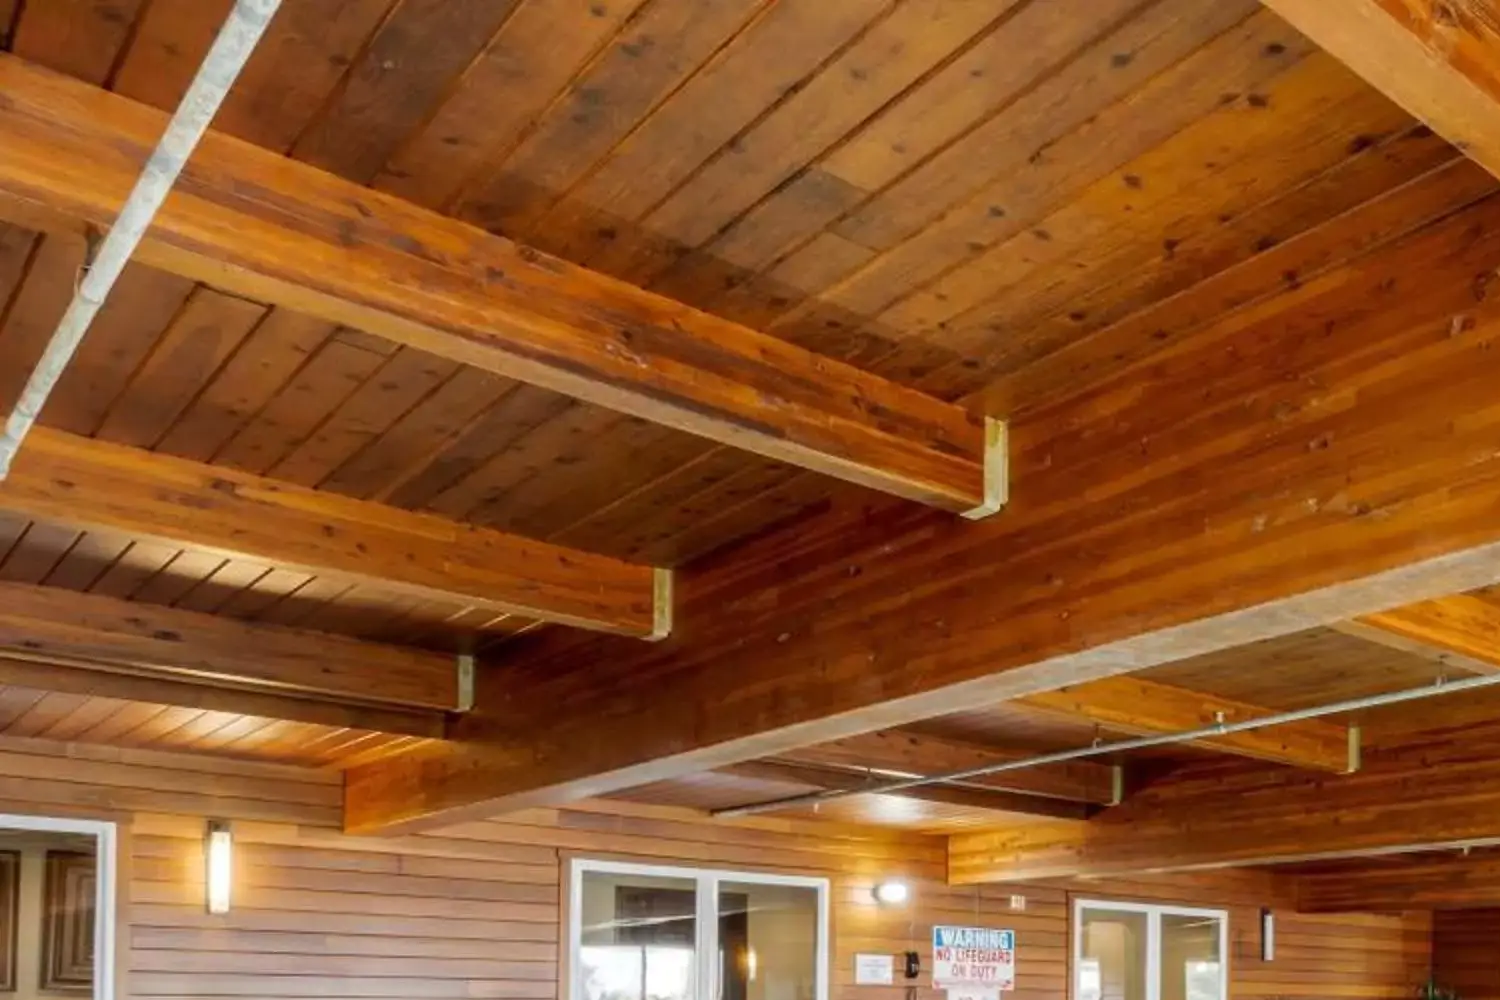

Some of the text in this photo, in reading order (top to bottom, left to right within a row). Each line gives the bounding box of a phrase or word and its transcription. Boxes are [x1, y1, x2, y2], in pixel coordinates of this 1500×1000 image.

[942, 928, 1010, 949] WARNING
[936, 949, 1011, 965] NO LIFEGUARD
[951, 963, 997, 978] ON DUTY
